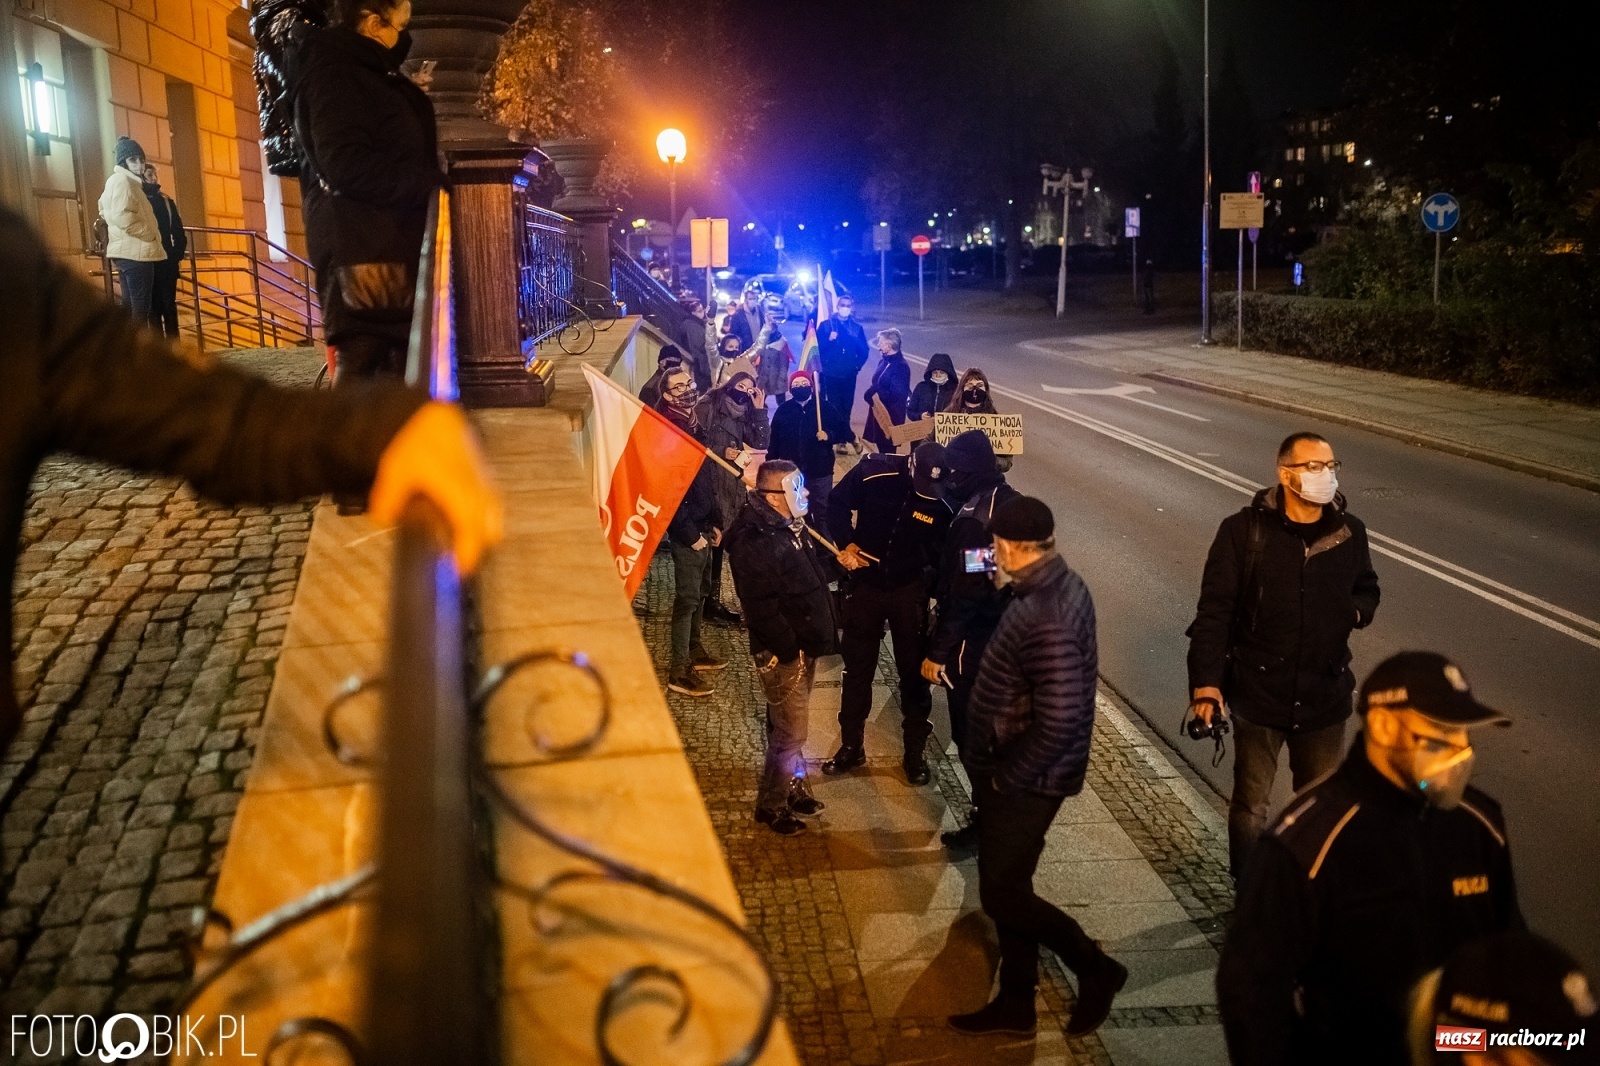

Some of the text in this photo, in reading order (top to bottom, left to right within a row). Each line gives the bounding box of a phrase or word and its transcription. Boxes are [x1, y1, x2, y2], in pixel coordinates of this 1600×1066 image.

[973, 416, 987, 425] TO
[991, 417, 1021, 428] TWOJA
[936, 425, 1022, 438] WINA TOJA BARDZO
[912, 511, 934, 524] POLICJA
